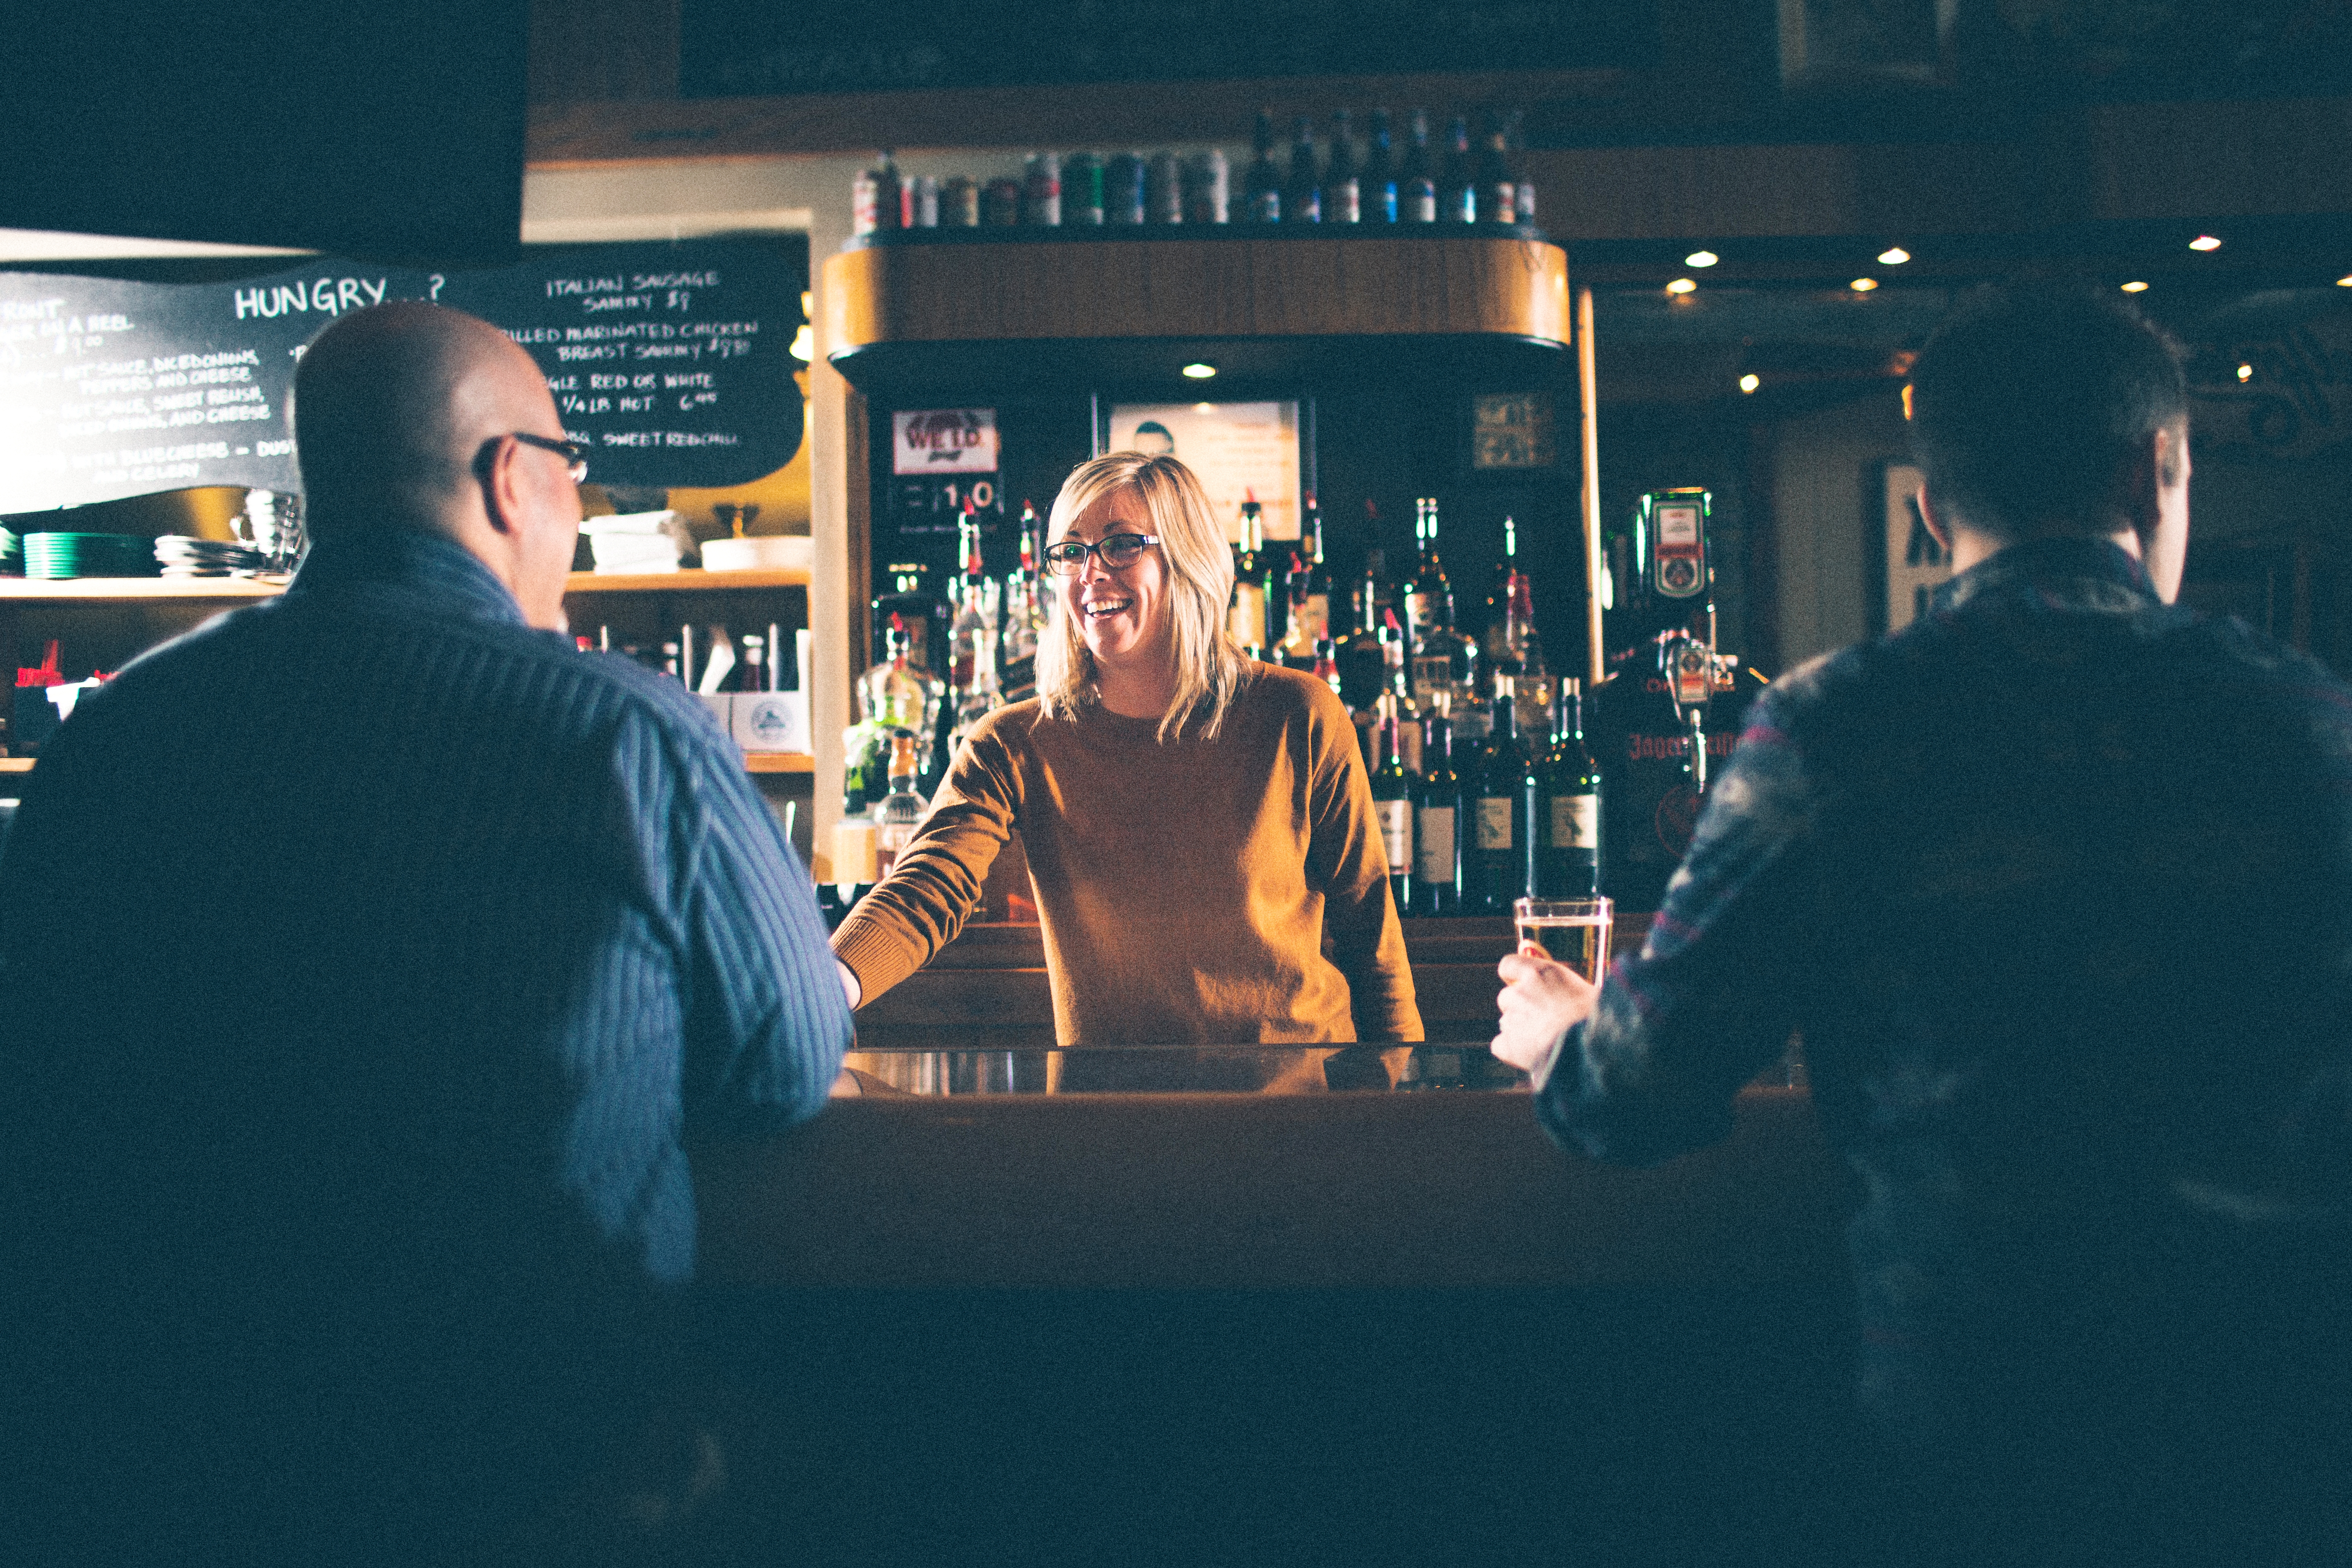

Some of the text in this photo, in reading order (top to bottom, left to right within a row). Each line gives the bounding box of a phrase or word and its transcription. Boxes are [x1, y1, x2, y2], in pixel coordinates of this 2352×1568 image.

[547, 270, 719, 298] ITALIAN SAUSAGE
[235, 277, 386, 319] HUNGRY
[583, 294, 653, 313] SAMMY
[504, 319, 759, 344] ILLED MARINATED CHICKEN
[556, 343, 629, 362] BREAST
[634, 343, 702, 362] SAMMY
[189, 367, 252, 385] CHEESE
[546, 371, 715, 393] GLE RED OR WHITE
[152, 391, 204, 411] SWEET
[169, 410, 205, 427] AND
[206, 404, 271, 423] CHEESE
[257, 439, 296, 457] DUST
[602, 431, 664, 447] SWEET
